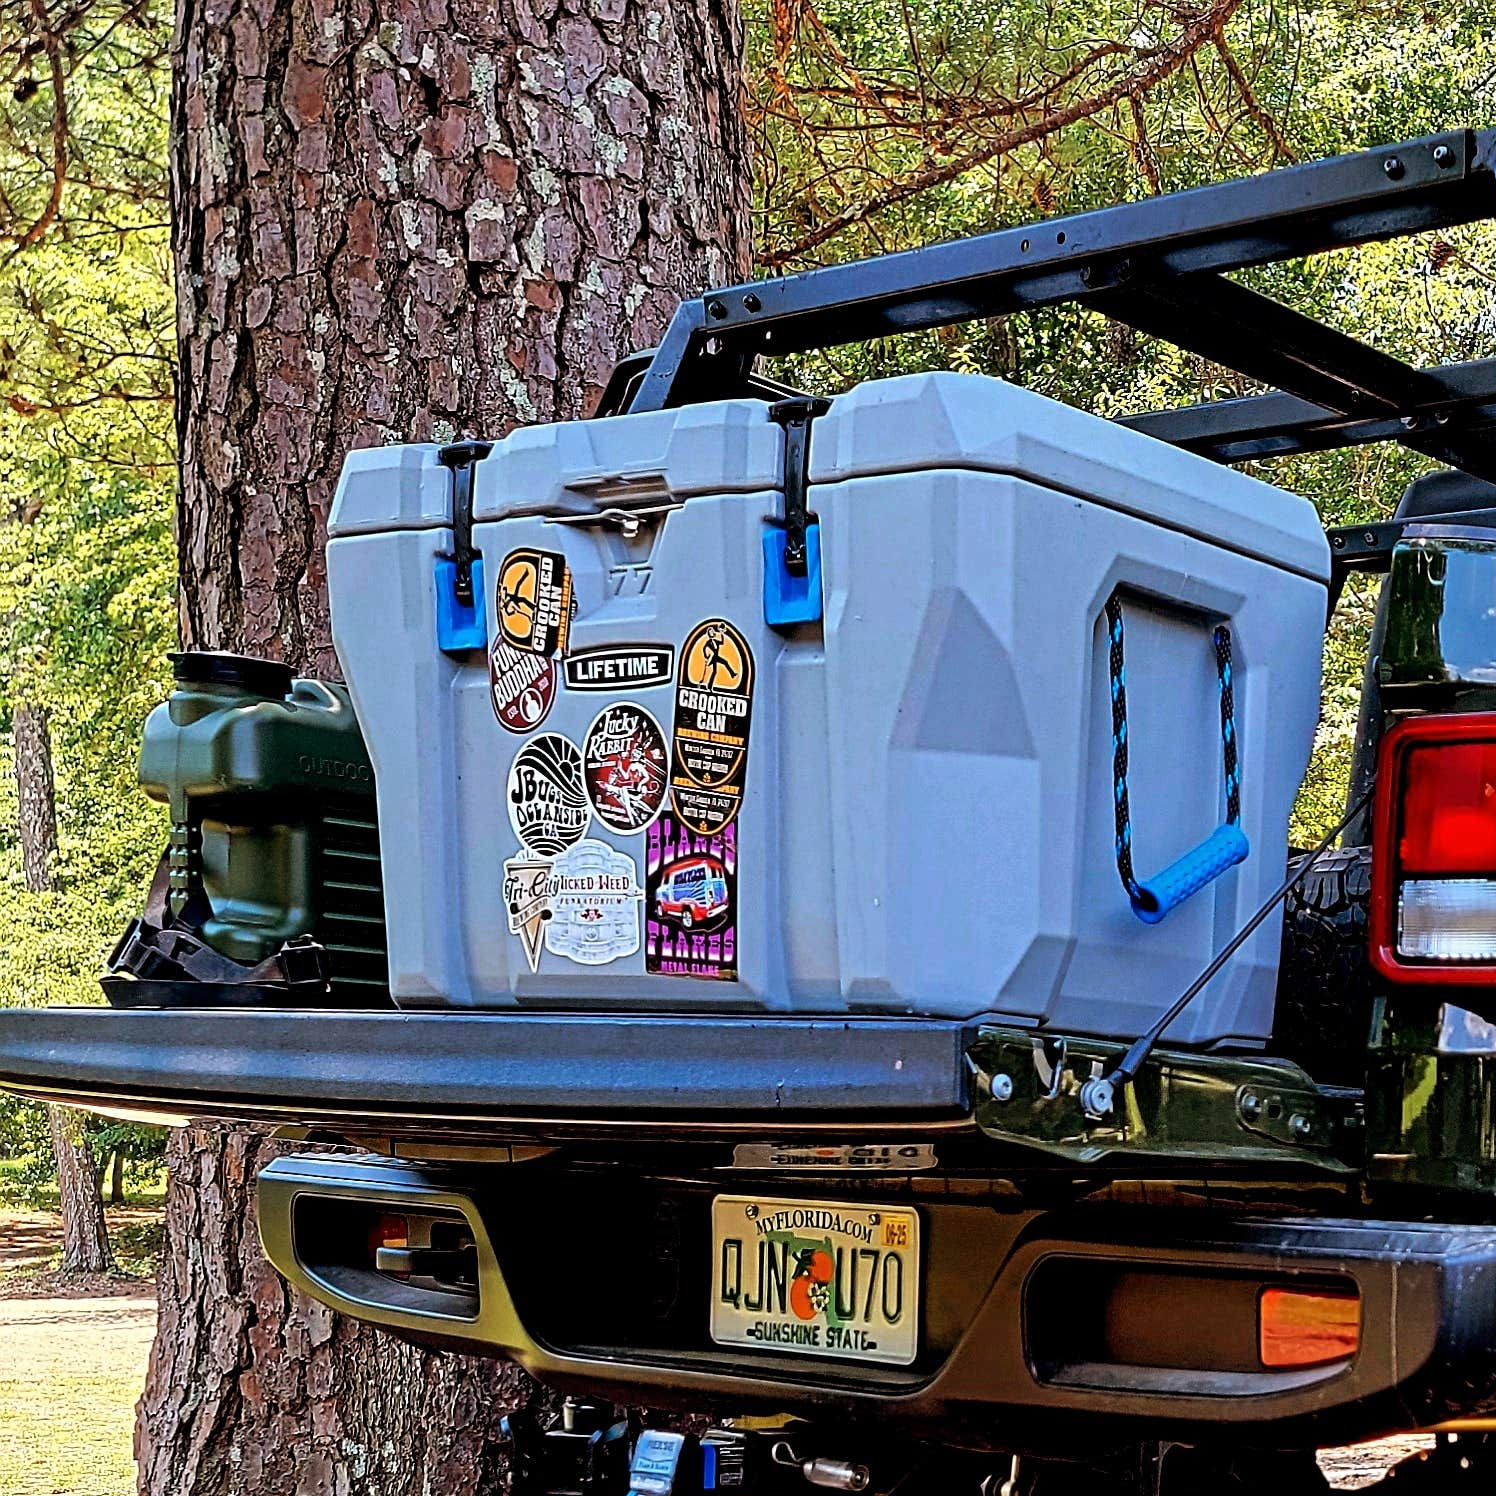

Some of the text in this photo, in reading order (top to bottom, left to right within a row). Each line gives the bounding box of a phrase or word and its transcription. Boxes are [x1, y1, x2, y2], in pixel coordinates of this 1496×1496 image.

[533, 557, 553, 651] CROOKED
[548, 585, 562, 627] CAN
[494, 653, 542, 710] BUDDHA
[577, 656, 659, 680] LIFETIME
[679, 689, 747, 717] CROOKED
[697, 711, 726, 733] CAN
[516, 803, 588, 828] OCEANSIDE
[505, 871, 560, 902] Tri-City
[599, 875, 629, 890] WEED
[647, 920, 734, 962] FLAKES
[754, 1209, 873, 1244] MYFLORIDA.COM
[721, 1238, 903, 1325] QJN U70
[754, 1321, 870, 1351] SUNSHINE STATE
